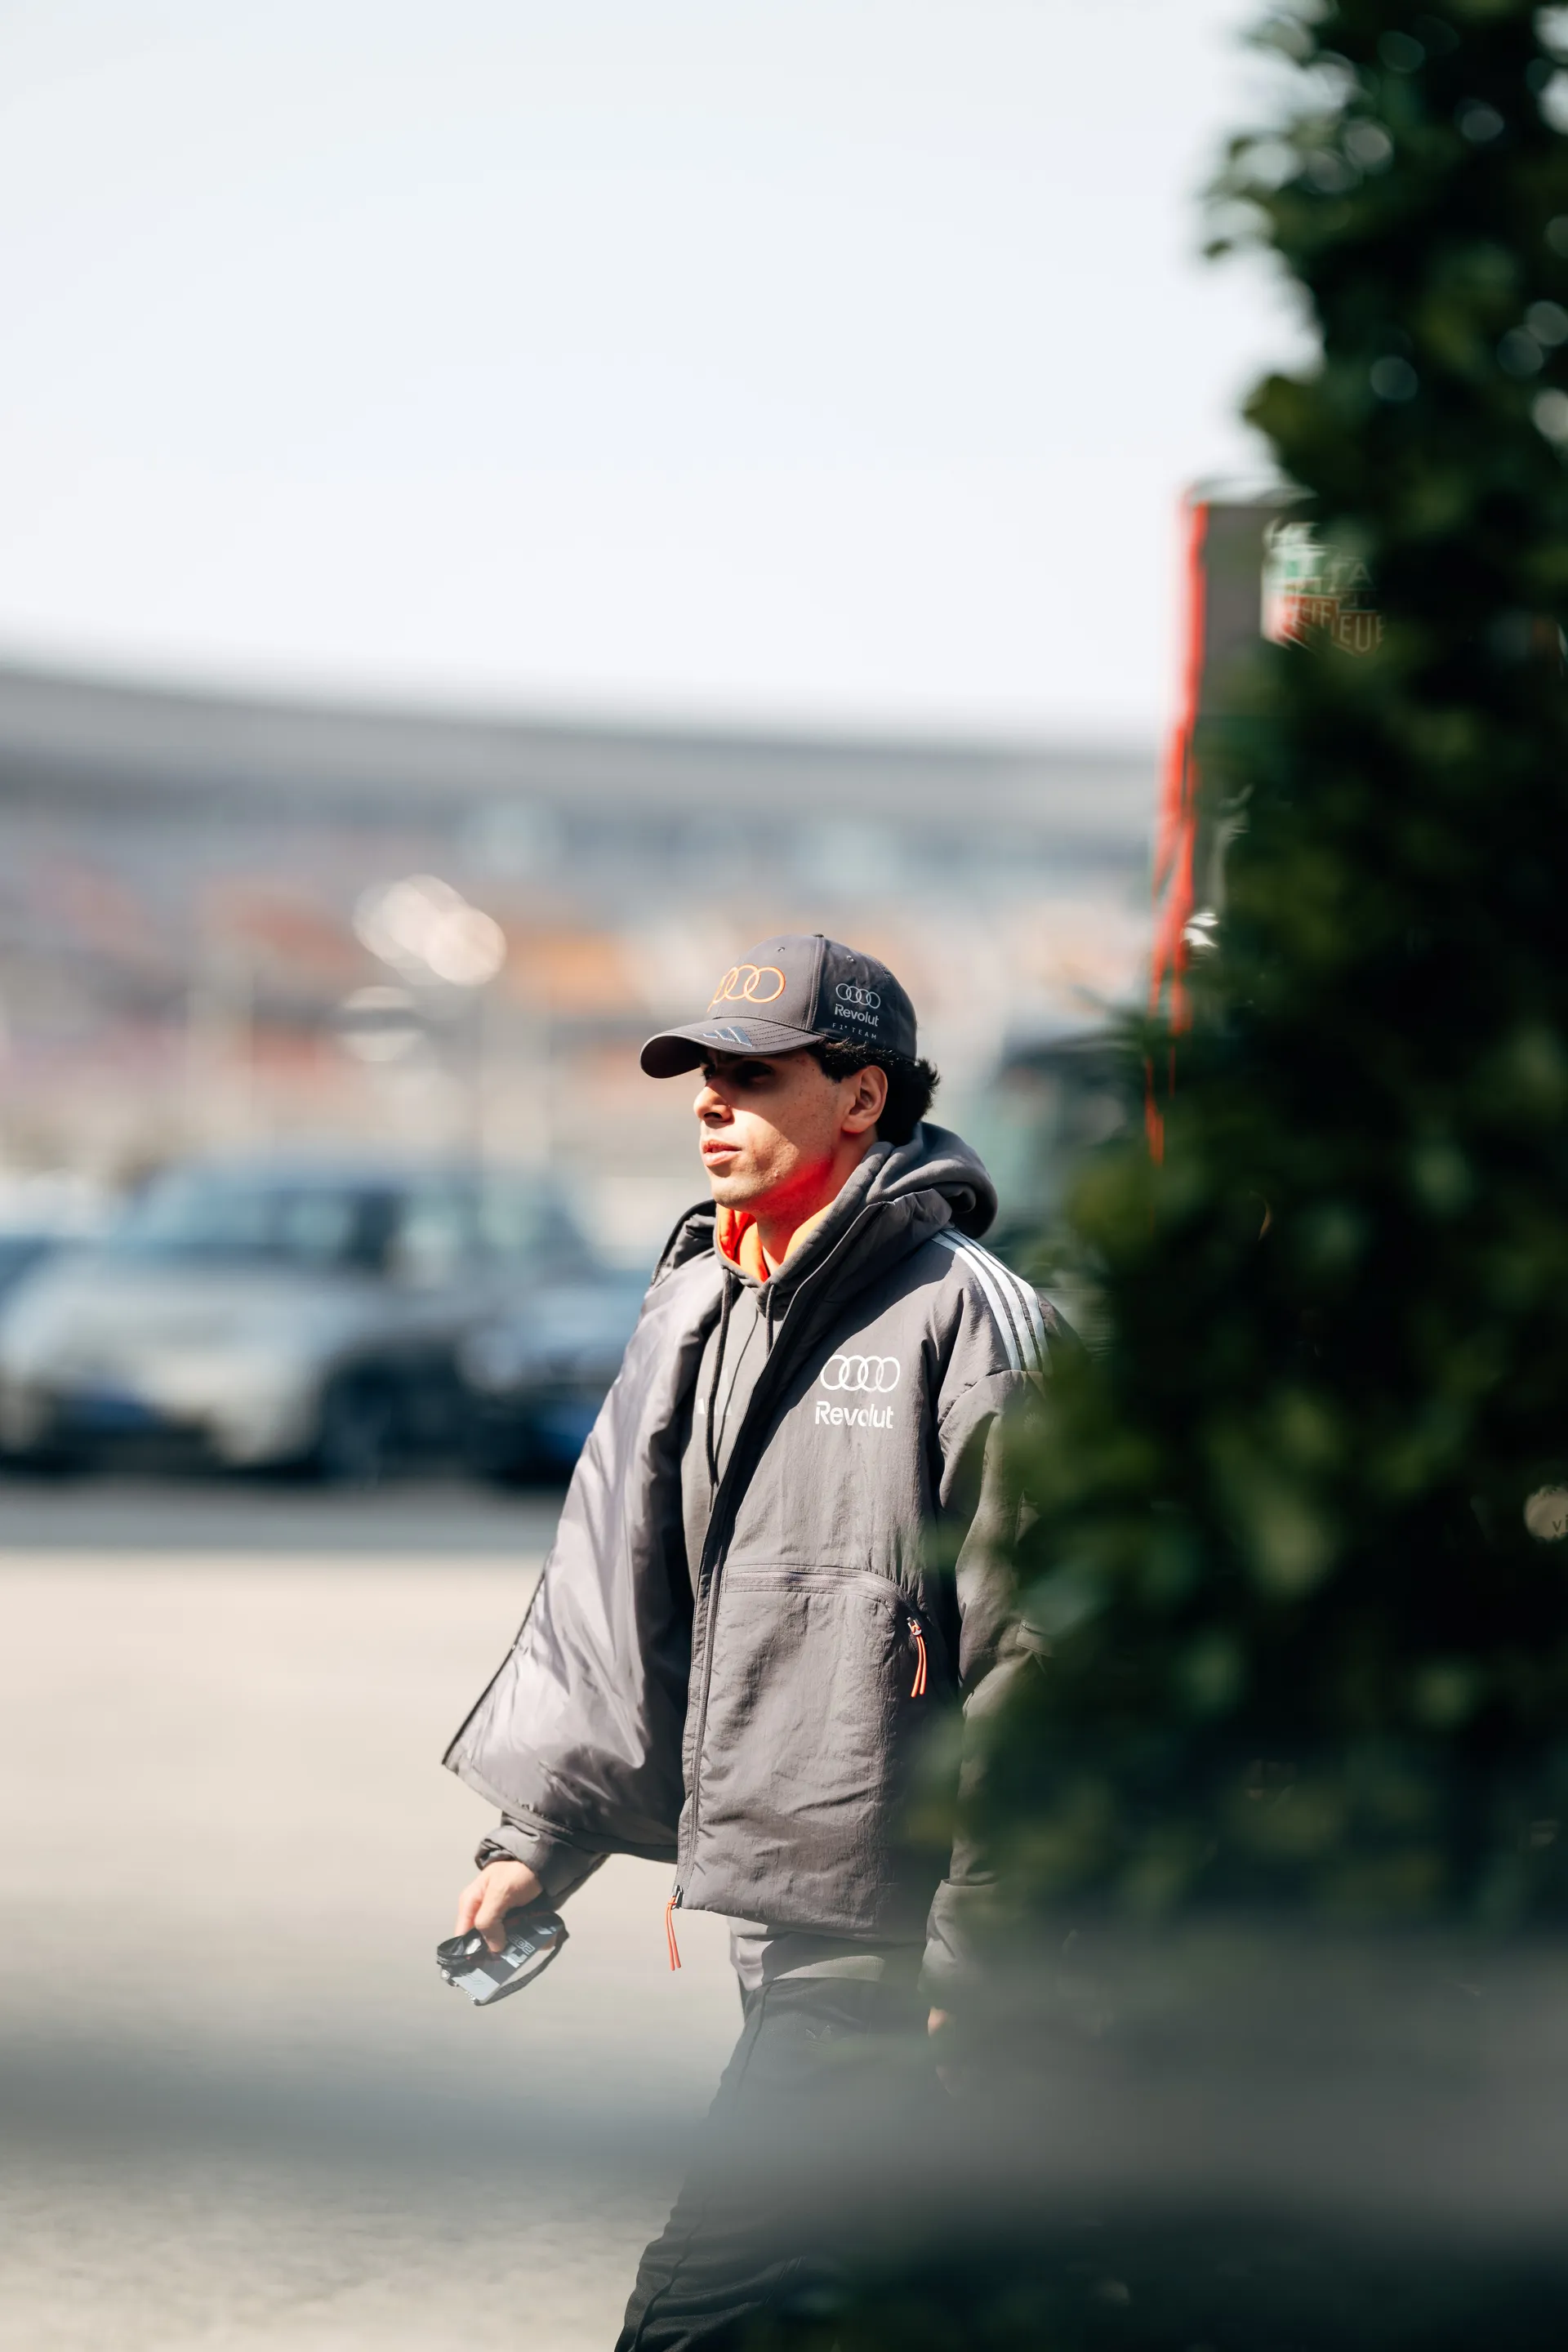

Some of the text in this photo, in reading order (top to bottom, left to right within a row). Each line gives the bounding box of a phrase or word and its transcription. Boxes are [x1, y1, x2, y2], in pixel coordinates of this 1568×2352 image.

[835, 1003, 880, 1027] Revolut
[852, 1027, 877, 1040] TEAM
[815, 1401, 894, 1429] Revolut
[509, 1933, 536, 1955] 202
